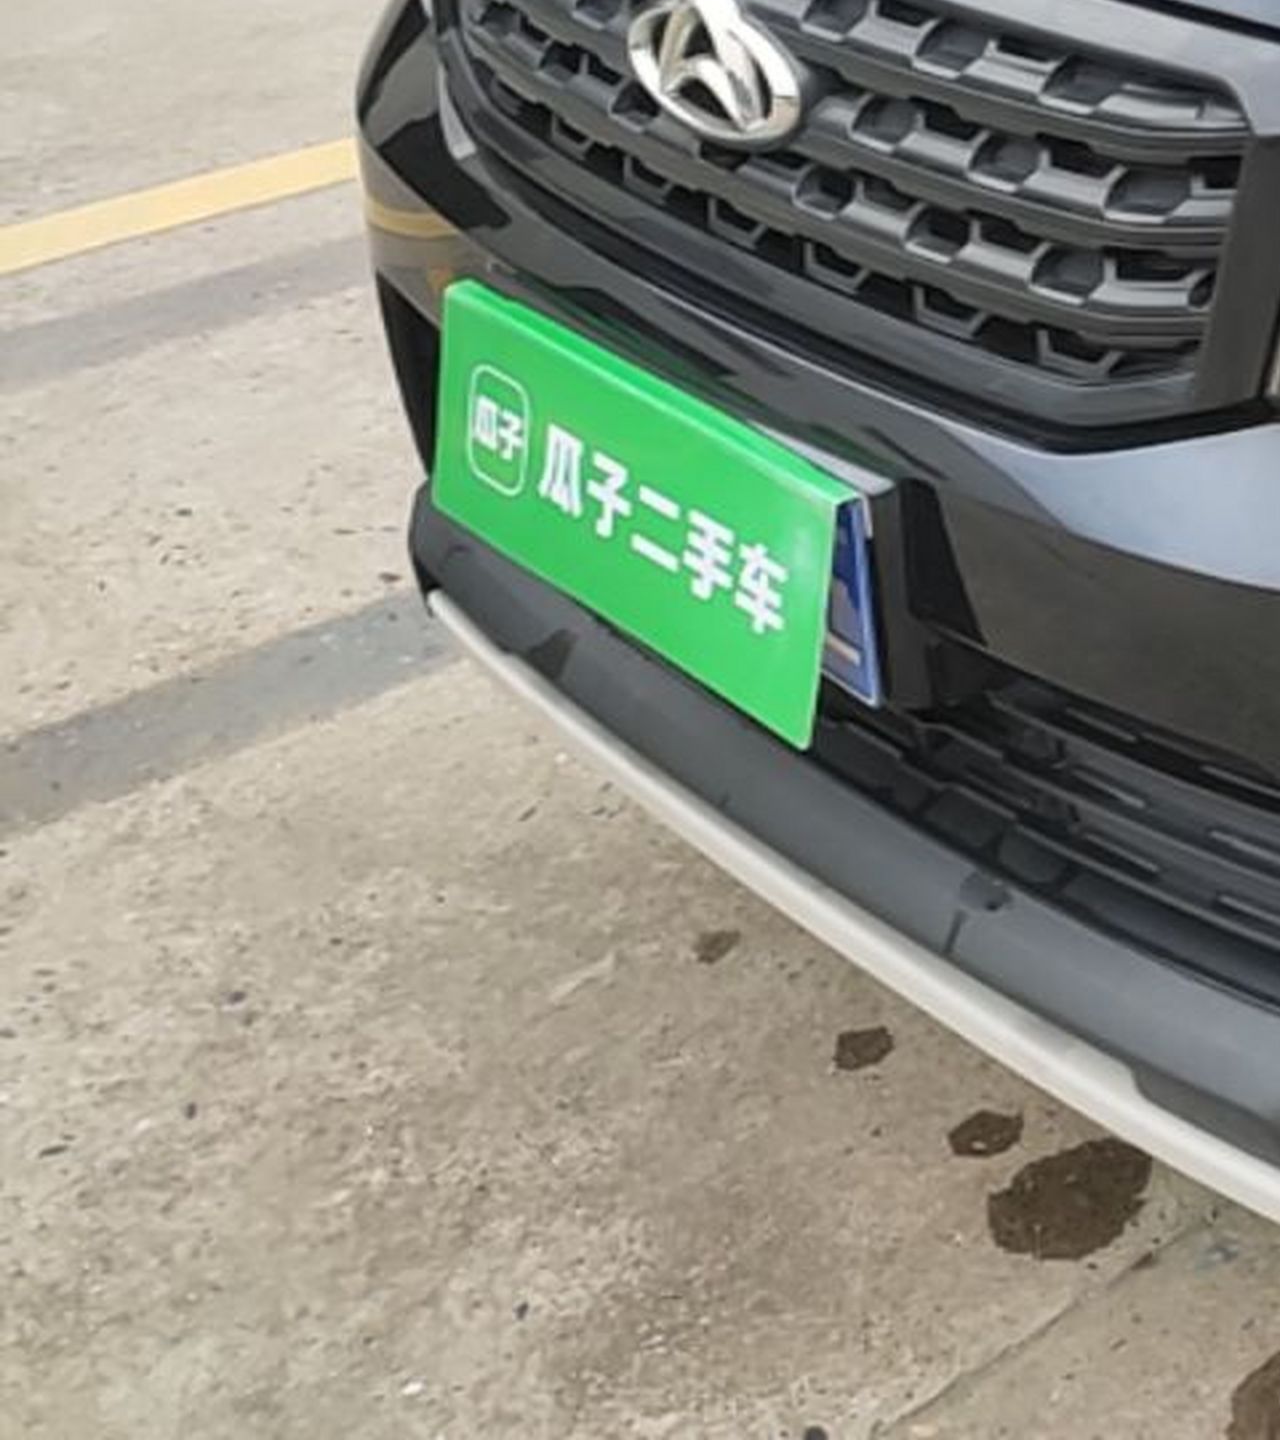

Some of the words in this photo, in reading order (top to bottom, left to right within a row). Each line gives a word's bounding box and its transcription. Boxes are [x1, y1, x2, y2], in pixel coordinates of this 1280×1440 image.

[472, 394, 525, 462] 瓜子
[537, 422, 791, 635] 瓜子二手车
